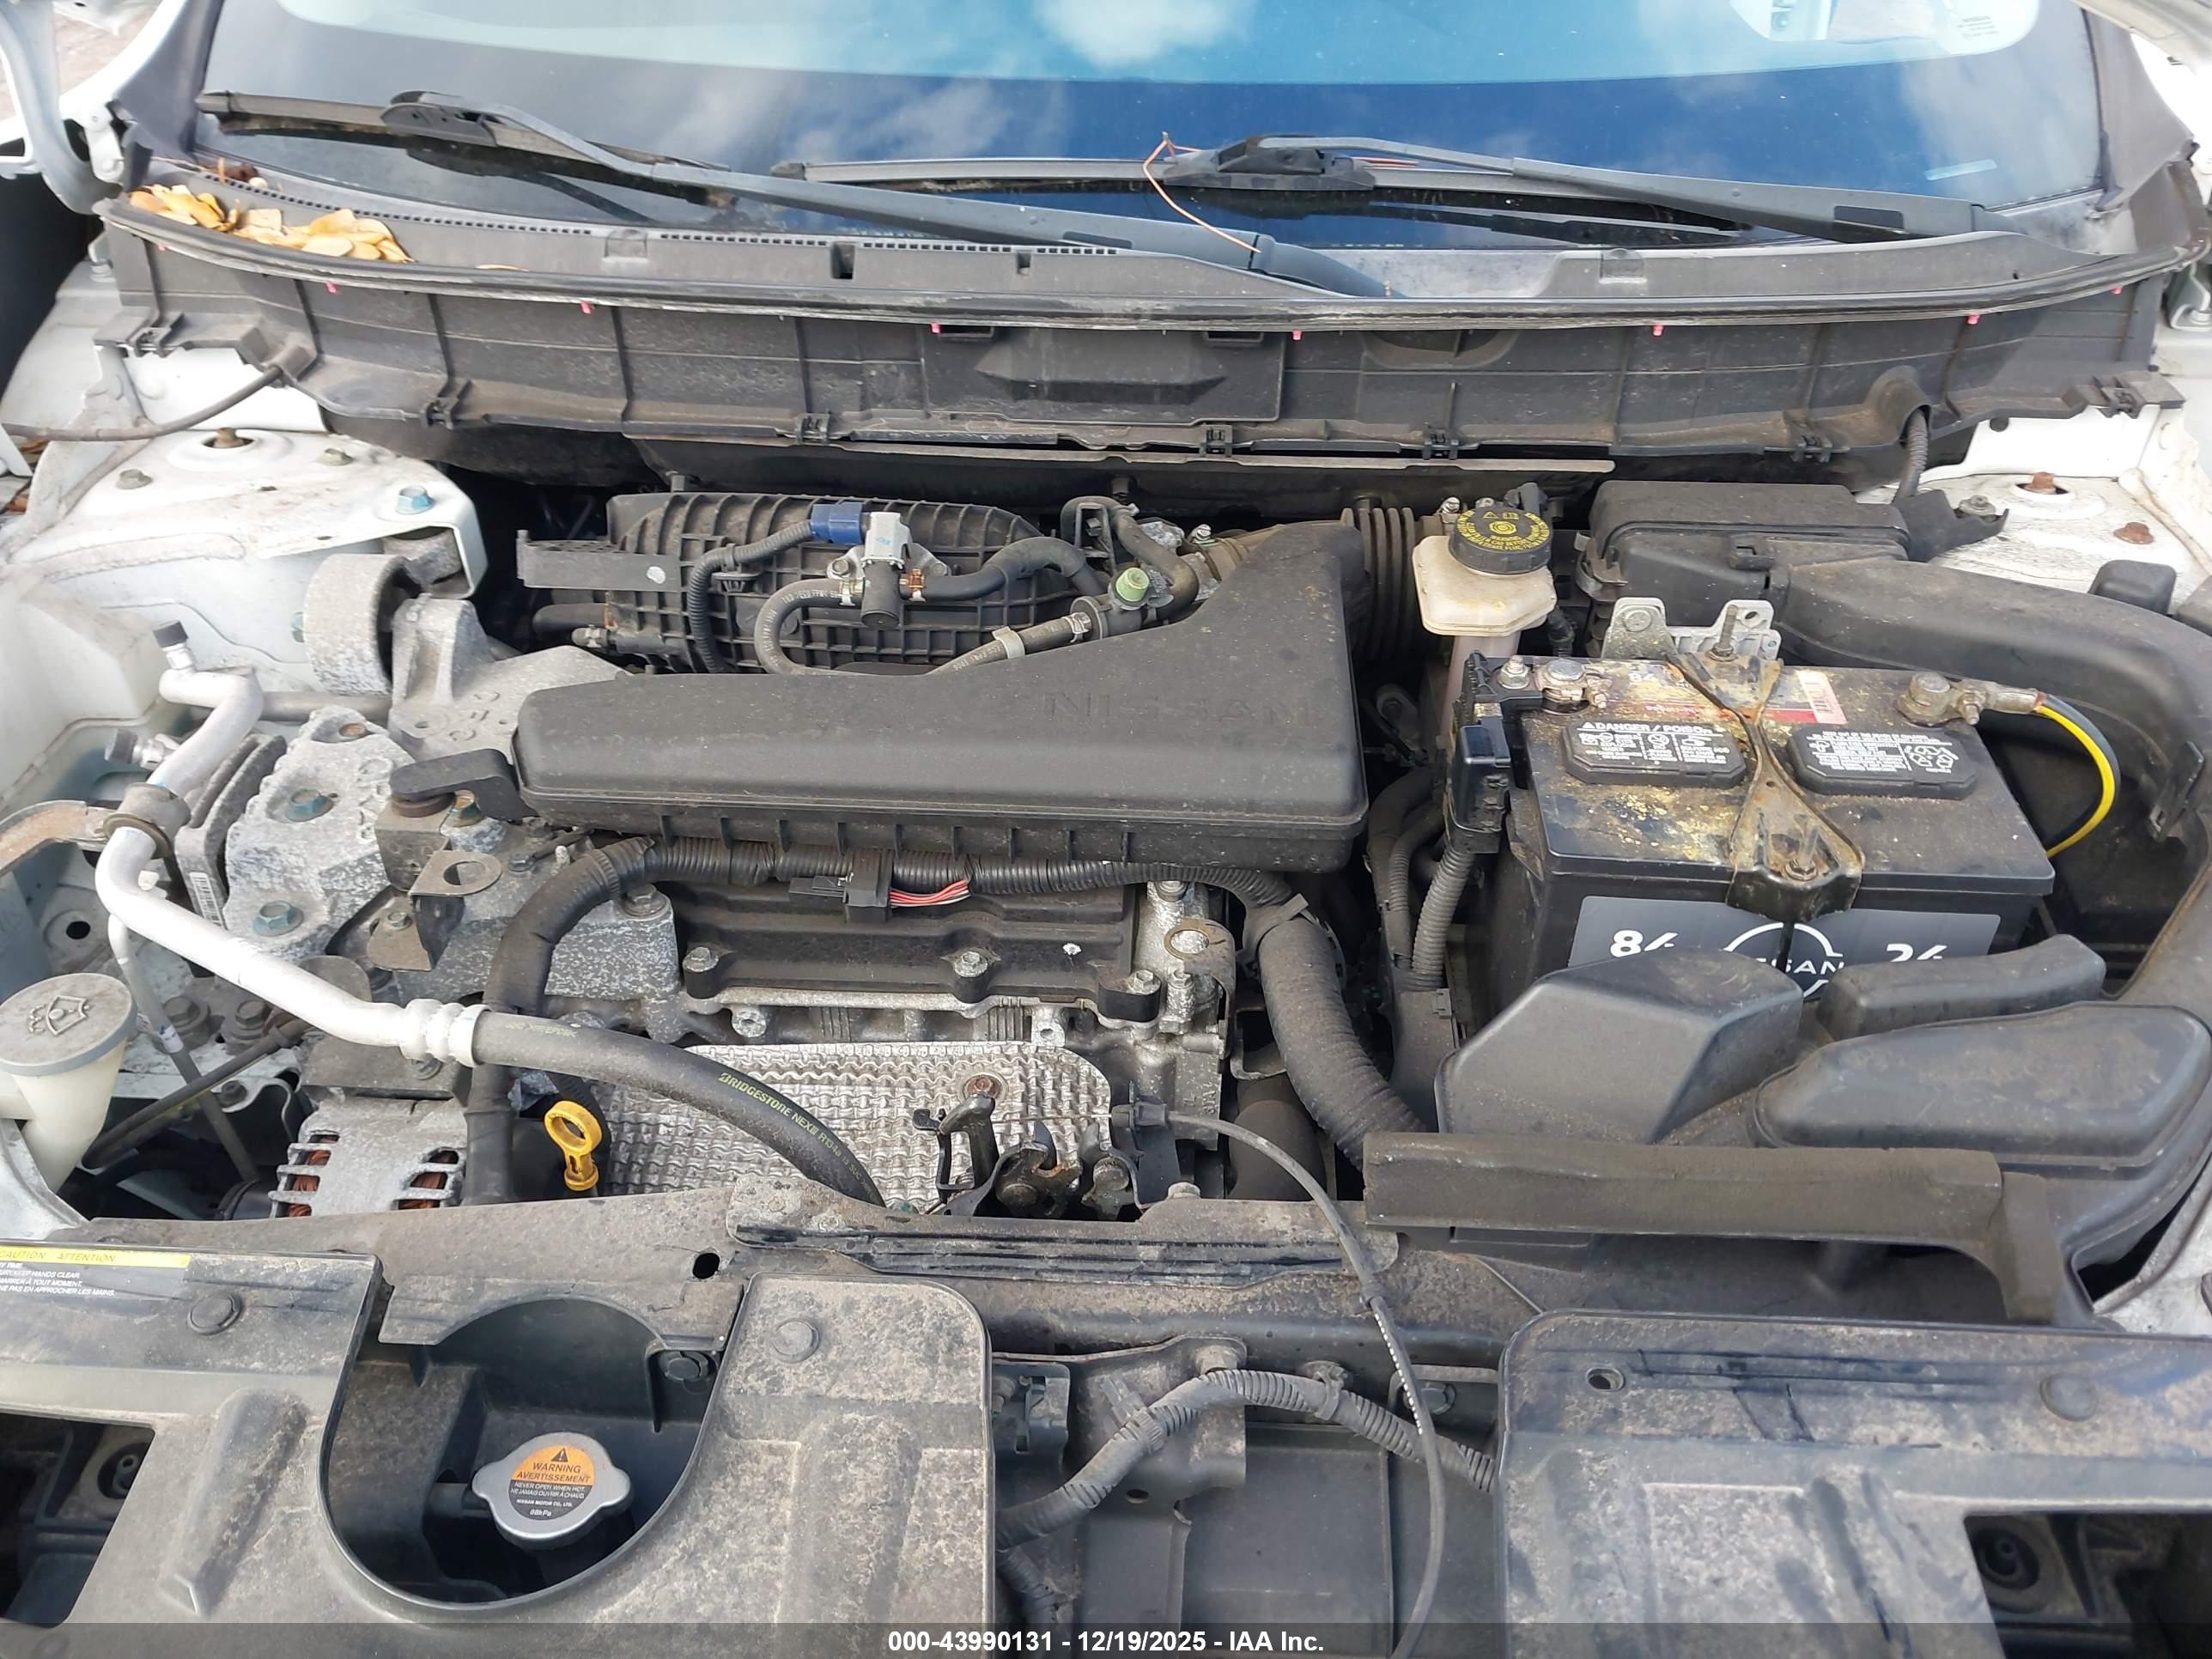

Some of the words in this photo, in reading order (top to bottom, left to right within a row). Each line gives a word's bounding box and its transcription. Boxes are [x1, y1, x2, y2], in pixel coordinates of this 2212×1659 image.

[1595, 722, 1650, 732] DANGER
[719, 1073, 793, 1116] BRIDGESTONE
[58, 1252, 116, 1262] ATTENTION
[532, 1462, 581, 1474] WARNING
[517, 1471, 591, 1483] AVERTISSEMENT
